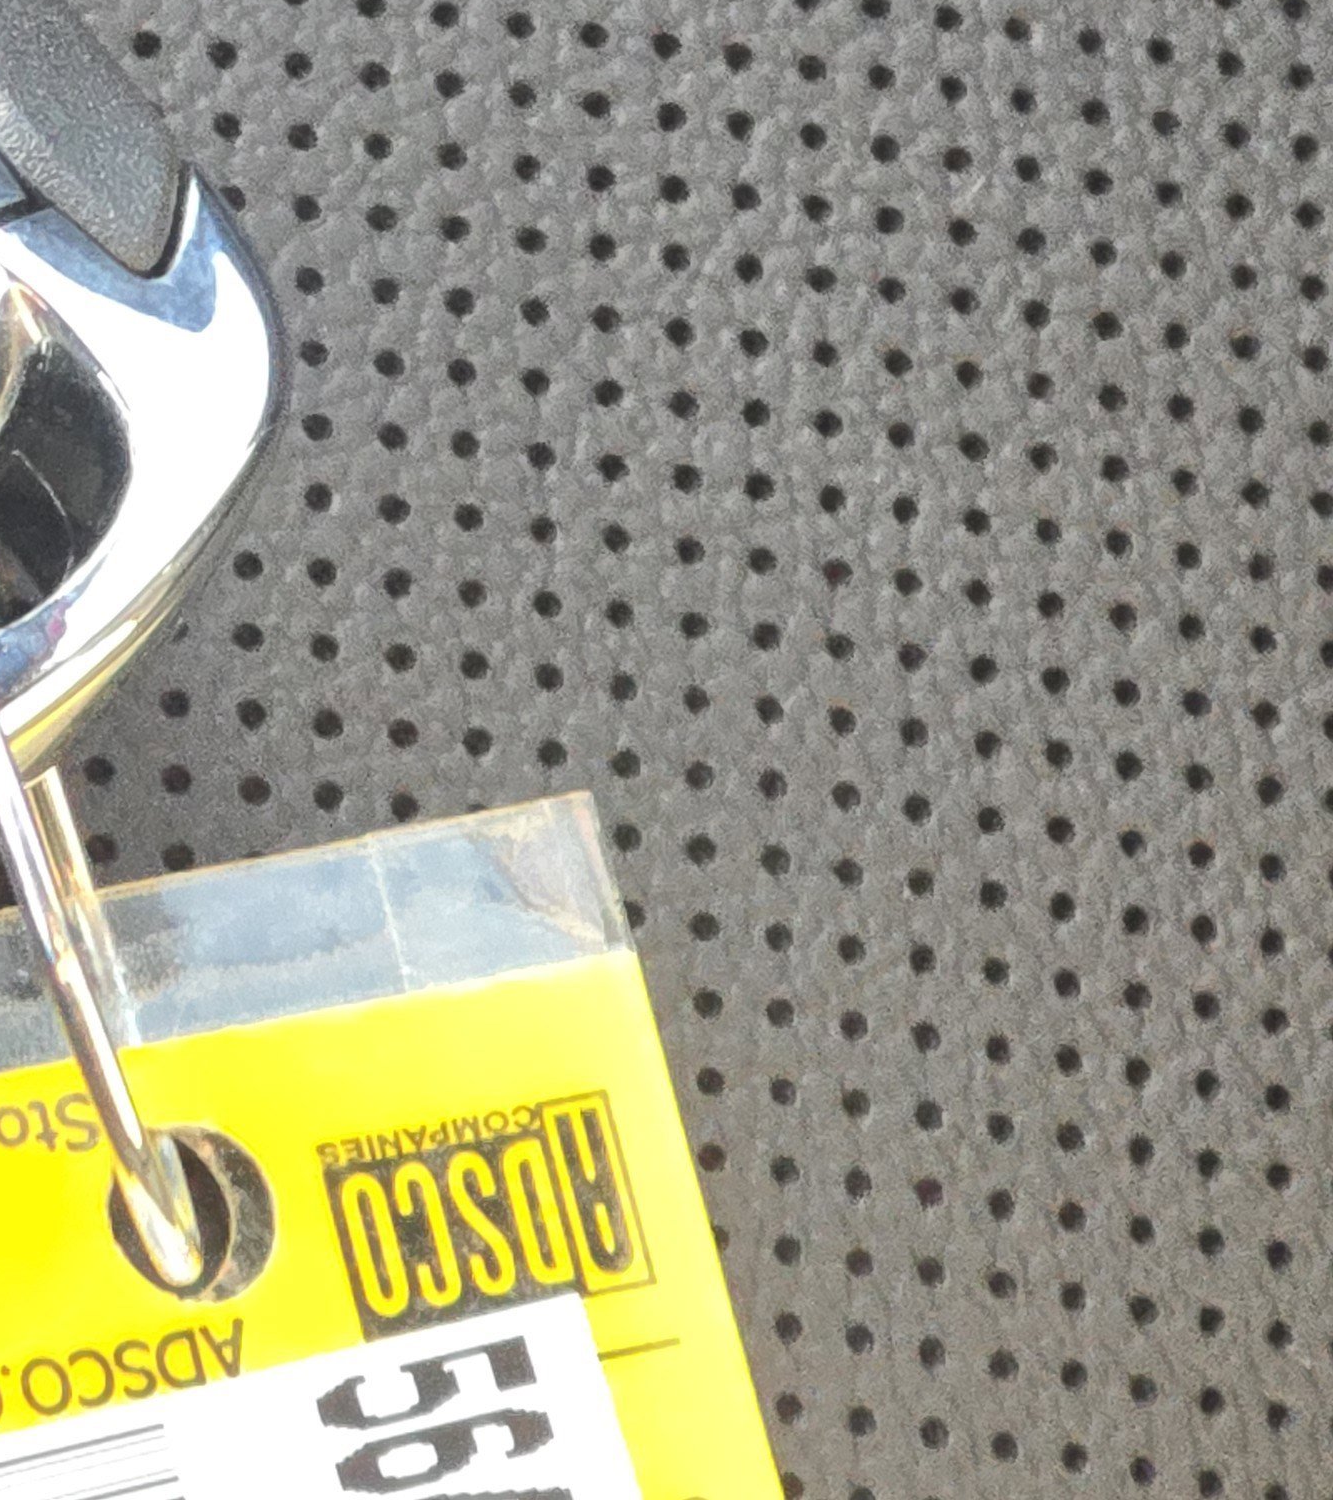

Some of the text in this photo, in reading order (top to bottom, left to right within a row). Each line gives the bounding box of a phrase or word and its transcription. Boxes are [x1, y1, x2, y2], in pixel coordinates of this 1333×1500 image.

[315, 1104, 541, 1165] COMPANIES
[340, 1105, 636, 1318] ADSCO
[315, 1335, 573, 1500] 56
